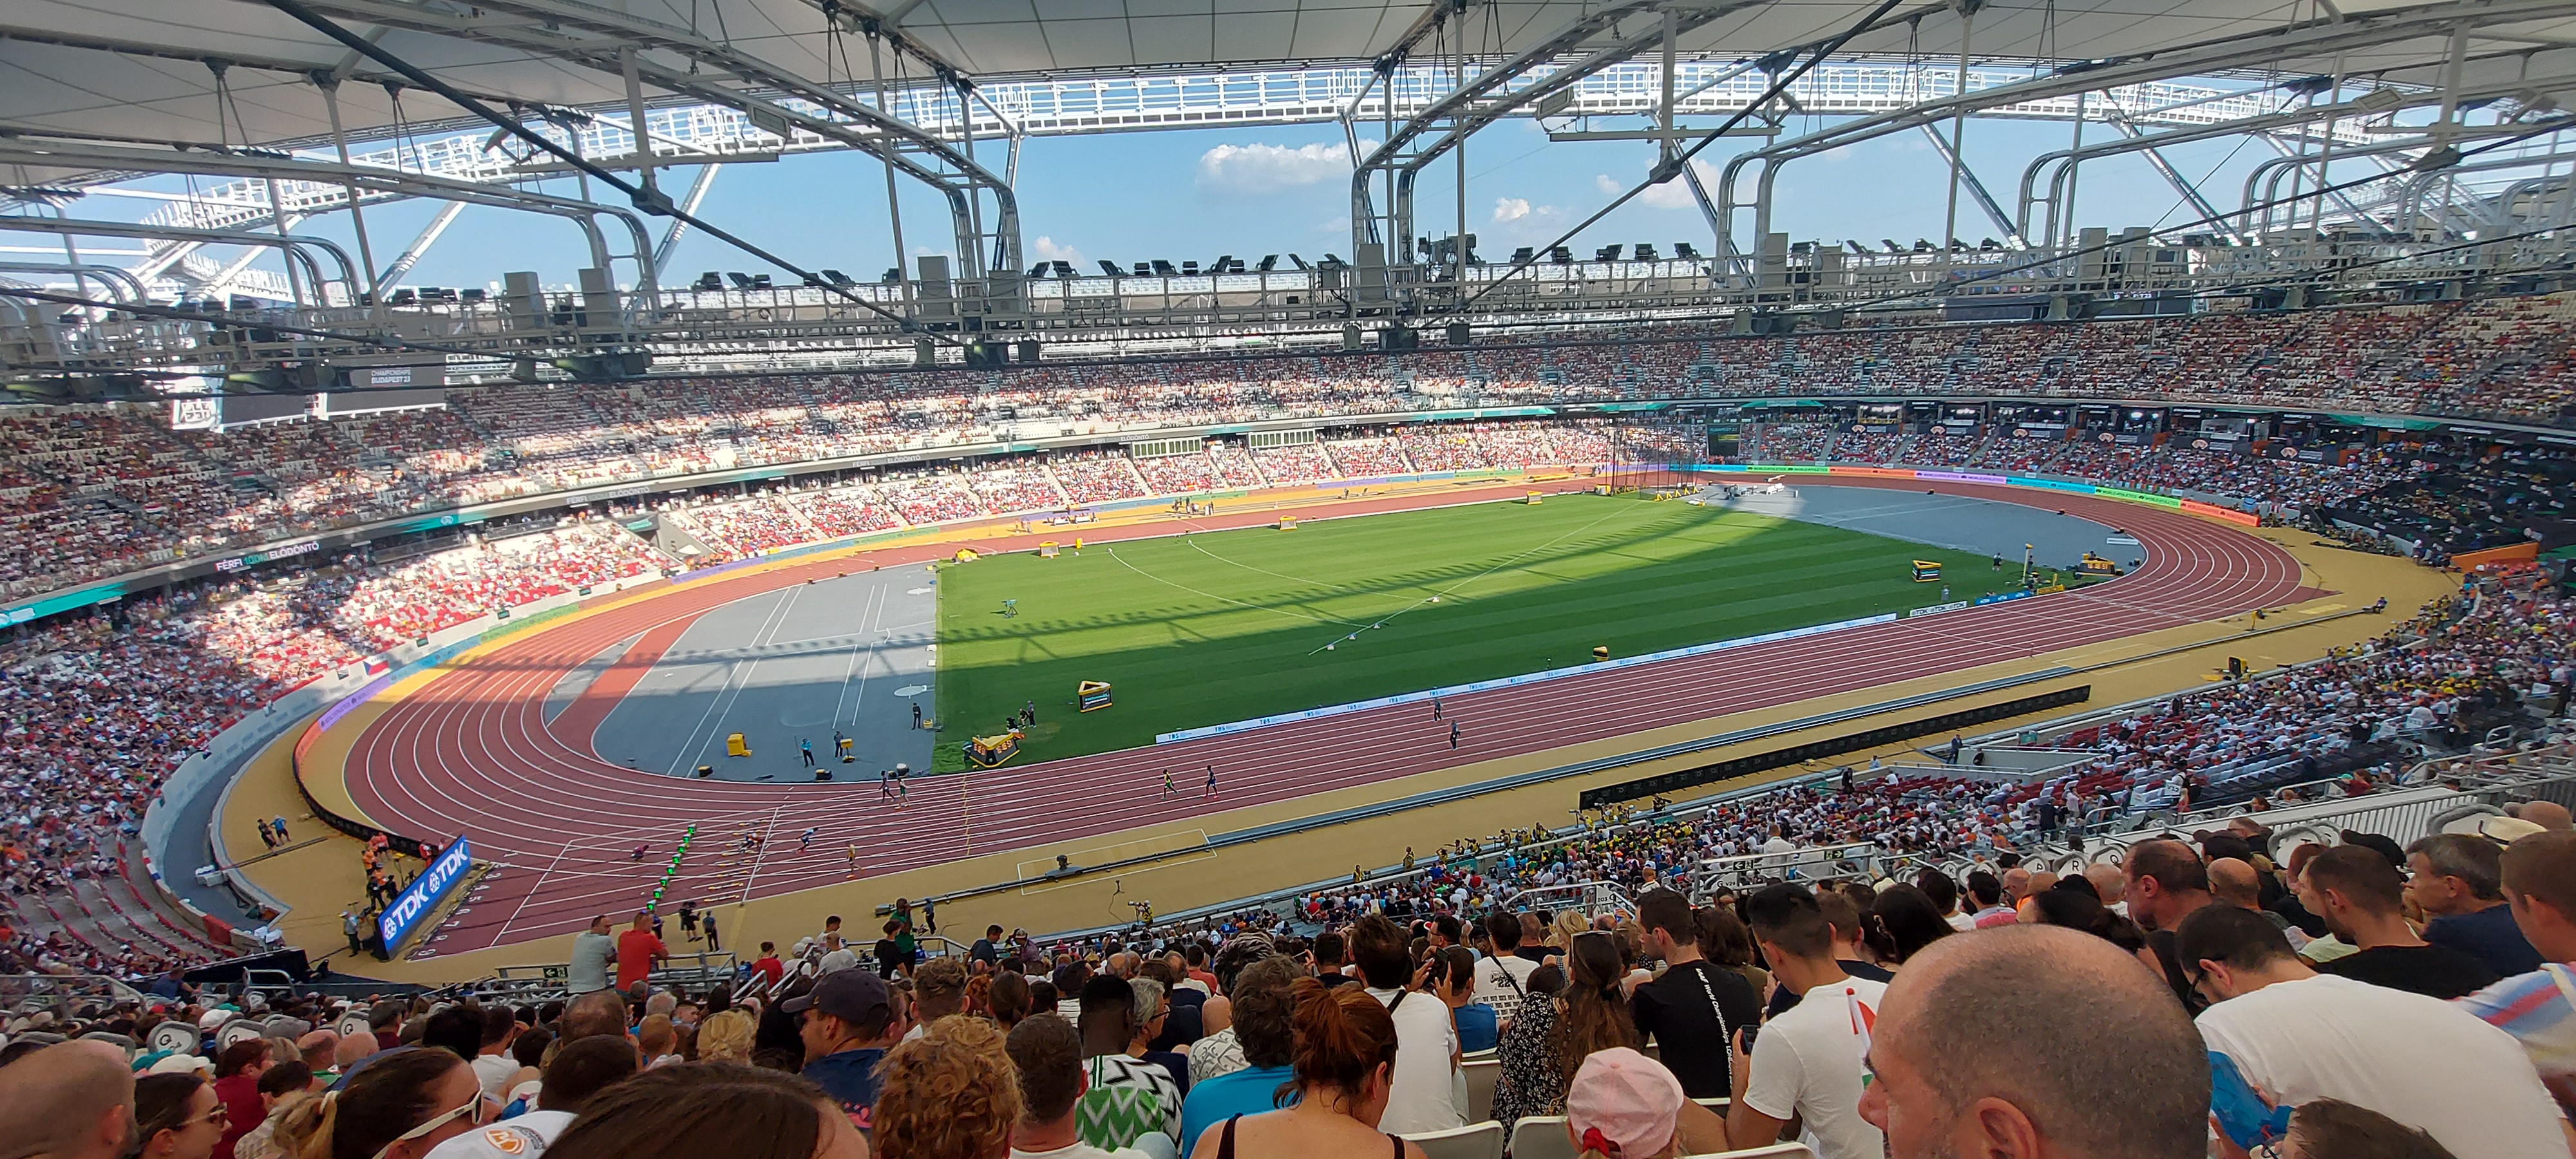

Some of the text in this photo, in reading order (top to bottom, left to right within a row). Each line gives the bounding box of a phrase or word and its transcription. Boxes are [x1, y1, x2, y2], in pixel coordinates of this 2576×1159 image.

[567, 496, 587, 504] FÉRFI
[215, 560, 242, 571] FÉRFI
[269, 541, 319, 560] ELŐDÖNTŐ
[2072, 860, 2079, 871] R
[392, 842, 468, 928] TDK TDK
[1498, 979, 1511, 987] 22
[1695, 968, 1709, 984] IAAF
[1704, 984, 1716, 1001] World
[1712, 1001, 1730, 1044] Championships
[159, 1033, 172, 1046] Q
